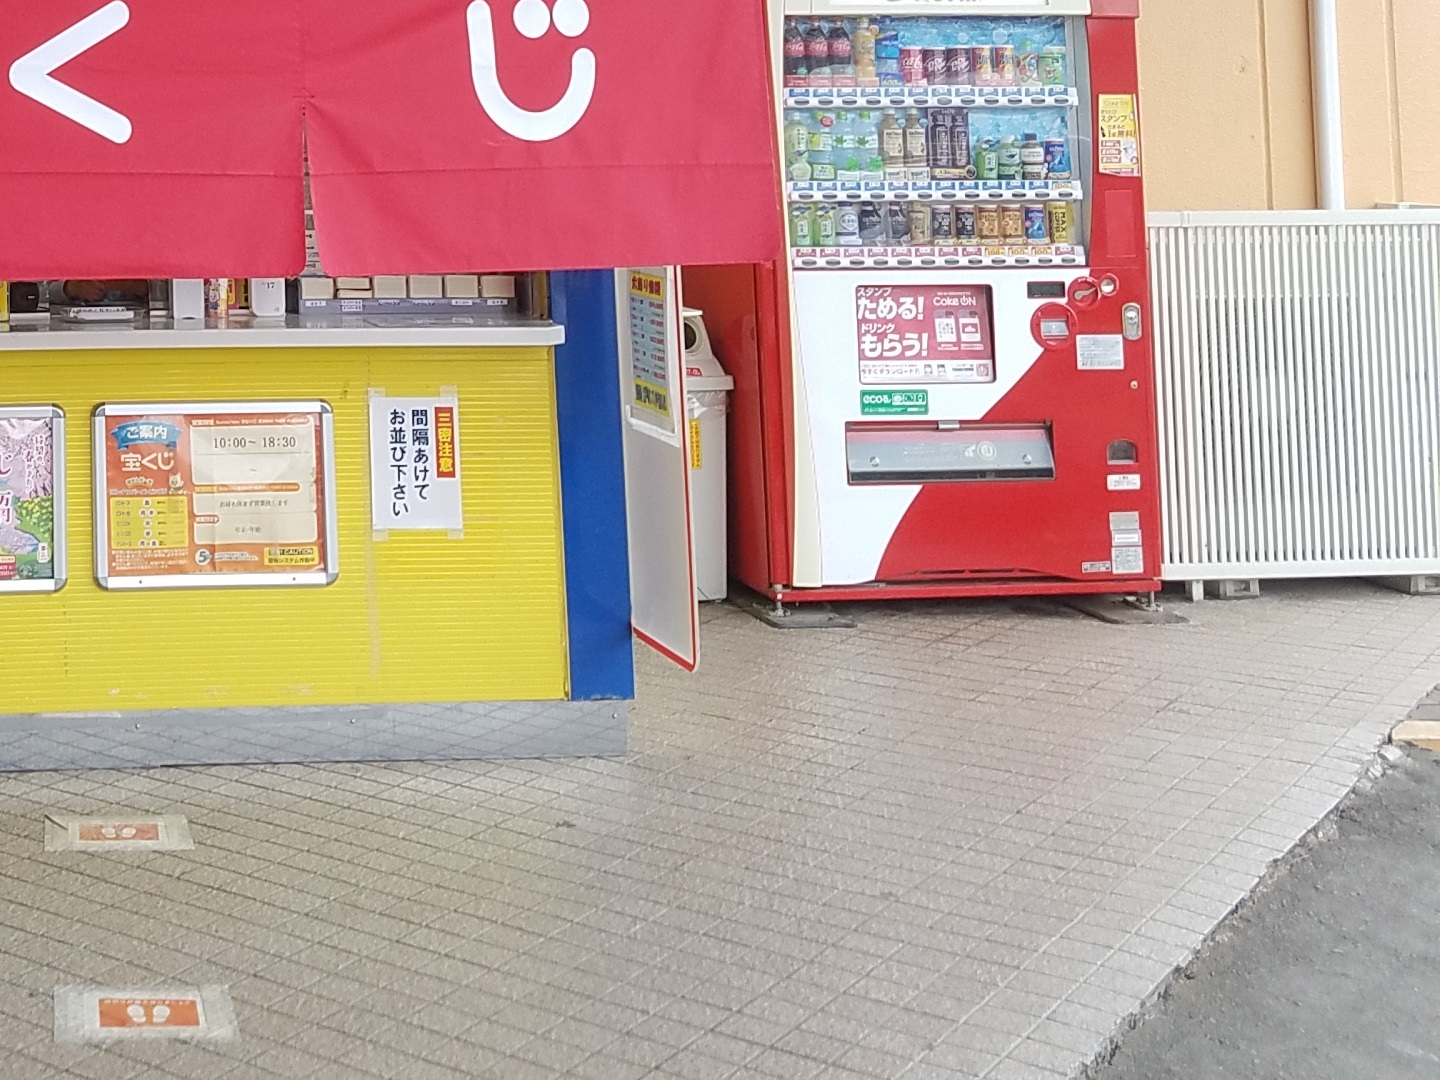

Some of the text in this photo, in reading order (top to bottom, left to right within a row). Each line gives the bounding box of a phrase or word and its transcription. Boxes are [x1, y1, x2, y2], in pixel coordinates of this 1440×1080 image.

[856, 286, 893, 297] スタンプ
[932, 296, 959, 306] Coke
[857, 296, 925, 320] ためる!
[861, 322, 896, 333] ドリンク
[860, 332, 929, 358] もらう!
[262, 436, 297, 448] 18:30
[120, 451, 175, 472] 宝くじ
[389, 408, 410, 517] お並び下さい
[411, 409, 430, 501] 間隔あけて
